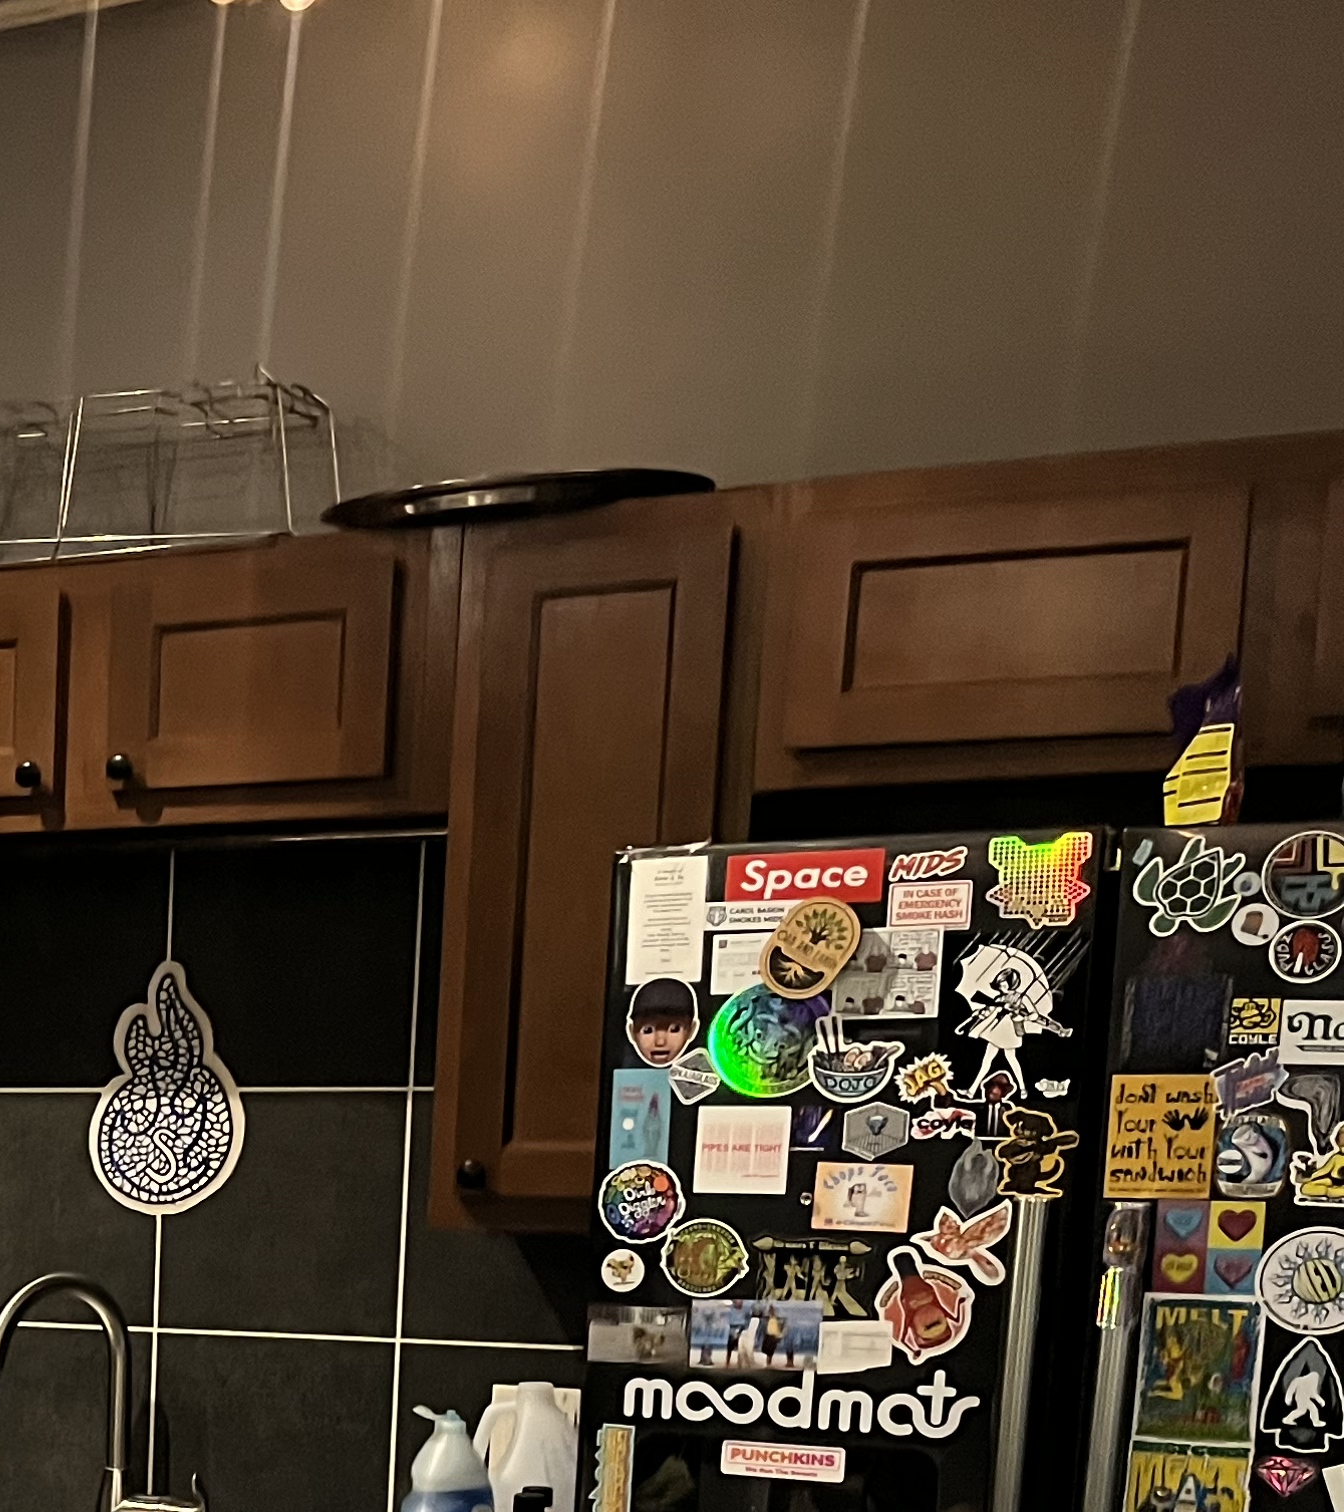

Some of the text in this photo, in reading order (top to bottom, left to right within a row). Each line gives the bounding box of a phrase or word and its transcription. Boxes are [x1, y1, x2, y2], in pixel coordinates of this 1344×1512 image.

[890, 848, 966, 880] MIDS
[740, 859, 869, 900] Space
[903, 887, 959, 898] IN CASE OF
[898, 898, 962, 910] EMERGENCY
[895, 908, 963, 921] SMOKE HASH
[1228, 1033, 1278, 1045] COYLE
[825, 1075, 877, 1092] DOJO
[903, 1062, 947, 1096] JAG
[1165, 1081, 1216, 1104] wash
[732, 1143, 751, 1153] ARE
[754, 1143, 782, 1153] TIGHT
[623, 1369, 981, 1439] moodmats
[730, 1447, 835, 1467] PUNCHKINS
